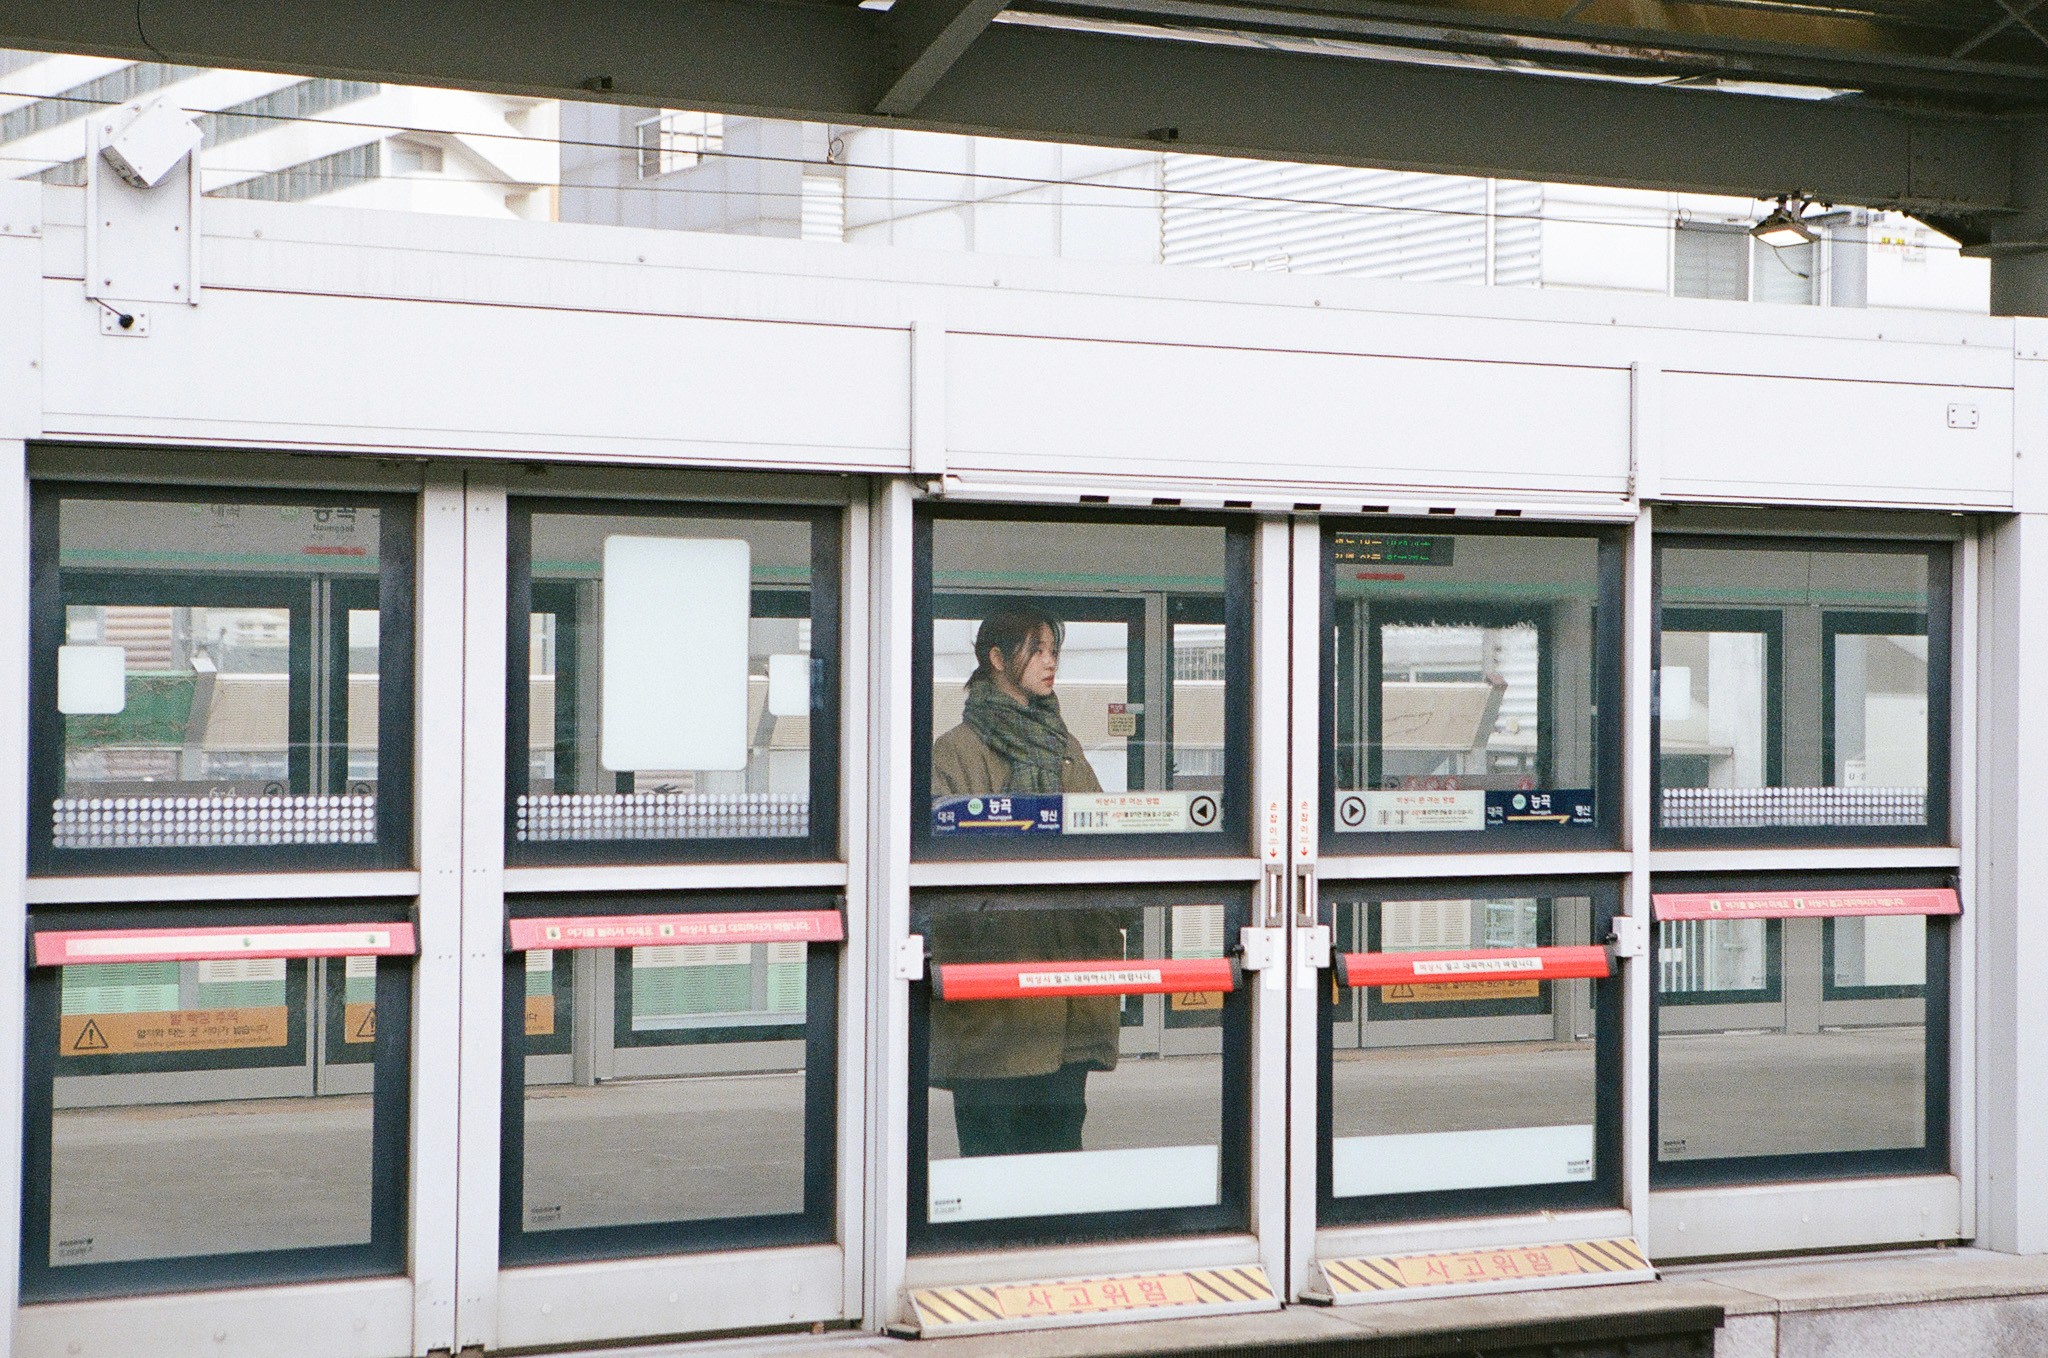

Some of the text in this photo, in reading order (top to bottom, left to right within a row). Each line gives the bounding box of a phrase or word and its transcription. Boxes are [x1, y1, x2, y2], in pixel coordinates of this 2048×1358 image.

[989, 798, 1012, 814] 능곡
[1531, 794, 1551, 809] 능곡
[1040, 810, 1058, 822] 행신
[1575, 805, 1592, 816] 행신
[937, 811, 956, 823] 대곡
